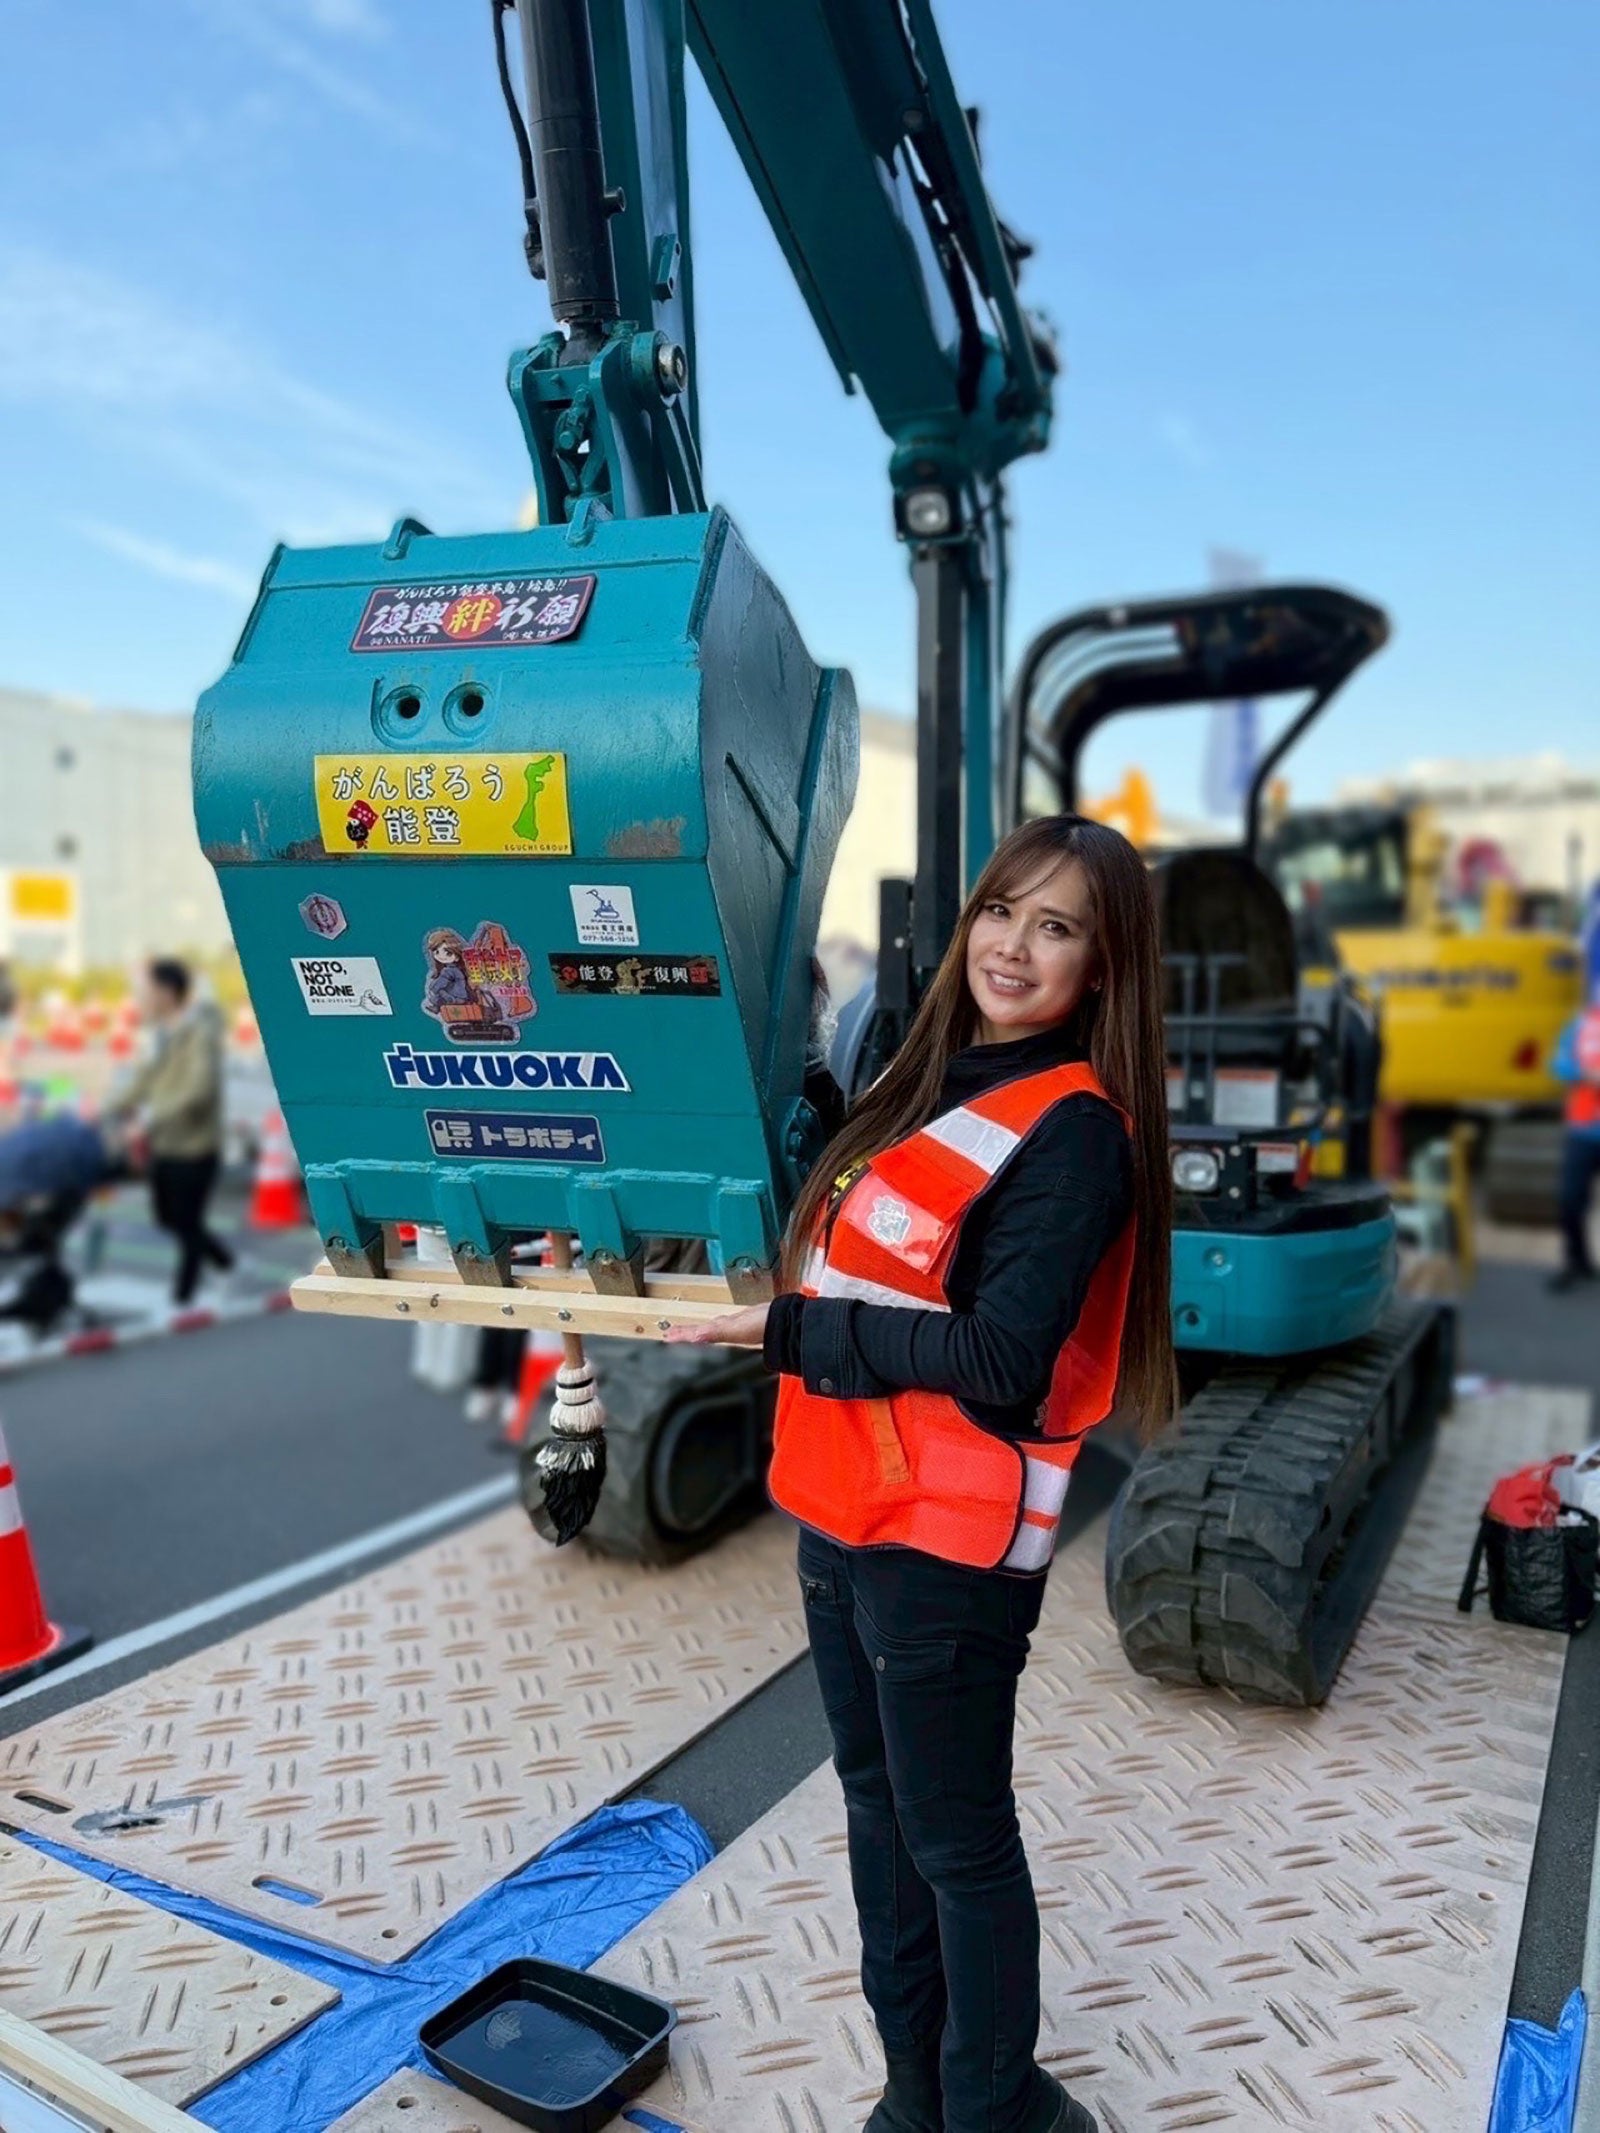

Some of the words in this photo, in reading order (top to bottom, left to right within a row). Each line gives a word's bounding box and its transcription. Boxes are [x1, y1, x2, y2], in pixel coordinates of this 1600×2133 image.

[332, 764, 504, 800] がんばろう
[382, 805, 461, 845] 能登
[539, 844, 569, 852] GROUP
[299, 961, 347, 975] NOTO,
[579, 964, 614, 981] 能登
[654, 966, 689, 983] 復興
[303, 974, 333, 985] NOT
[309, 985, 355, 997] ALONE
[387, 1045, 626, 1088] FUKUOKA
[480, 1125, 596, 1151] トラボディ
